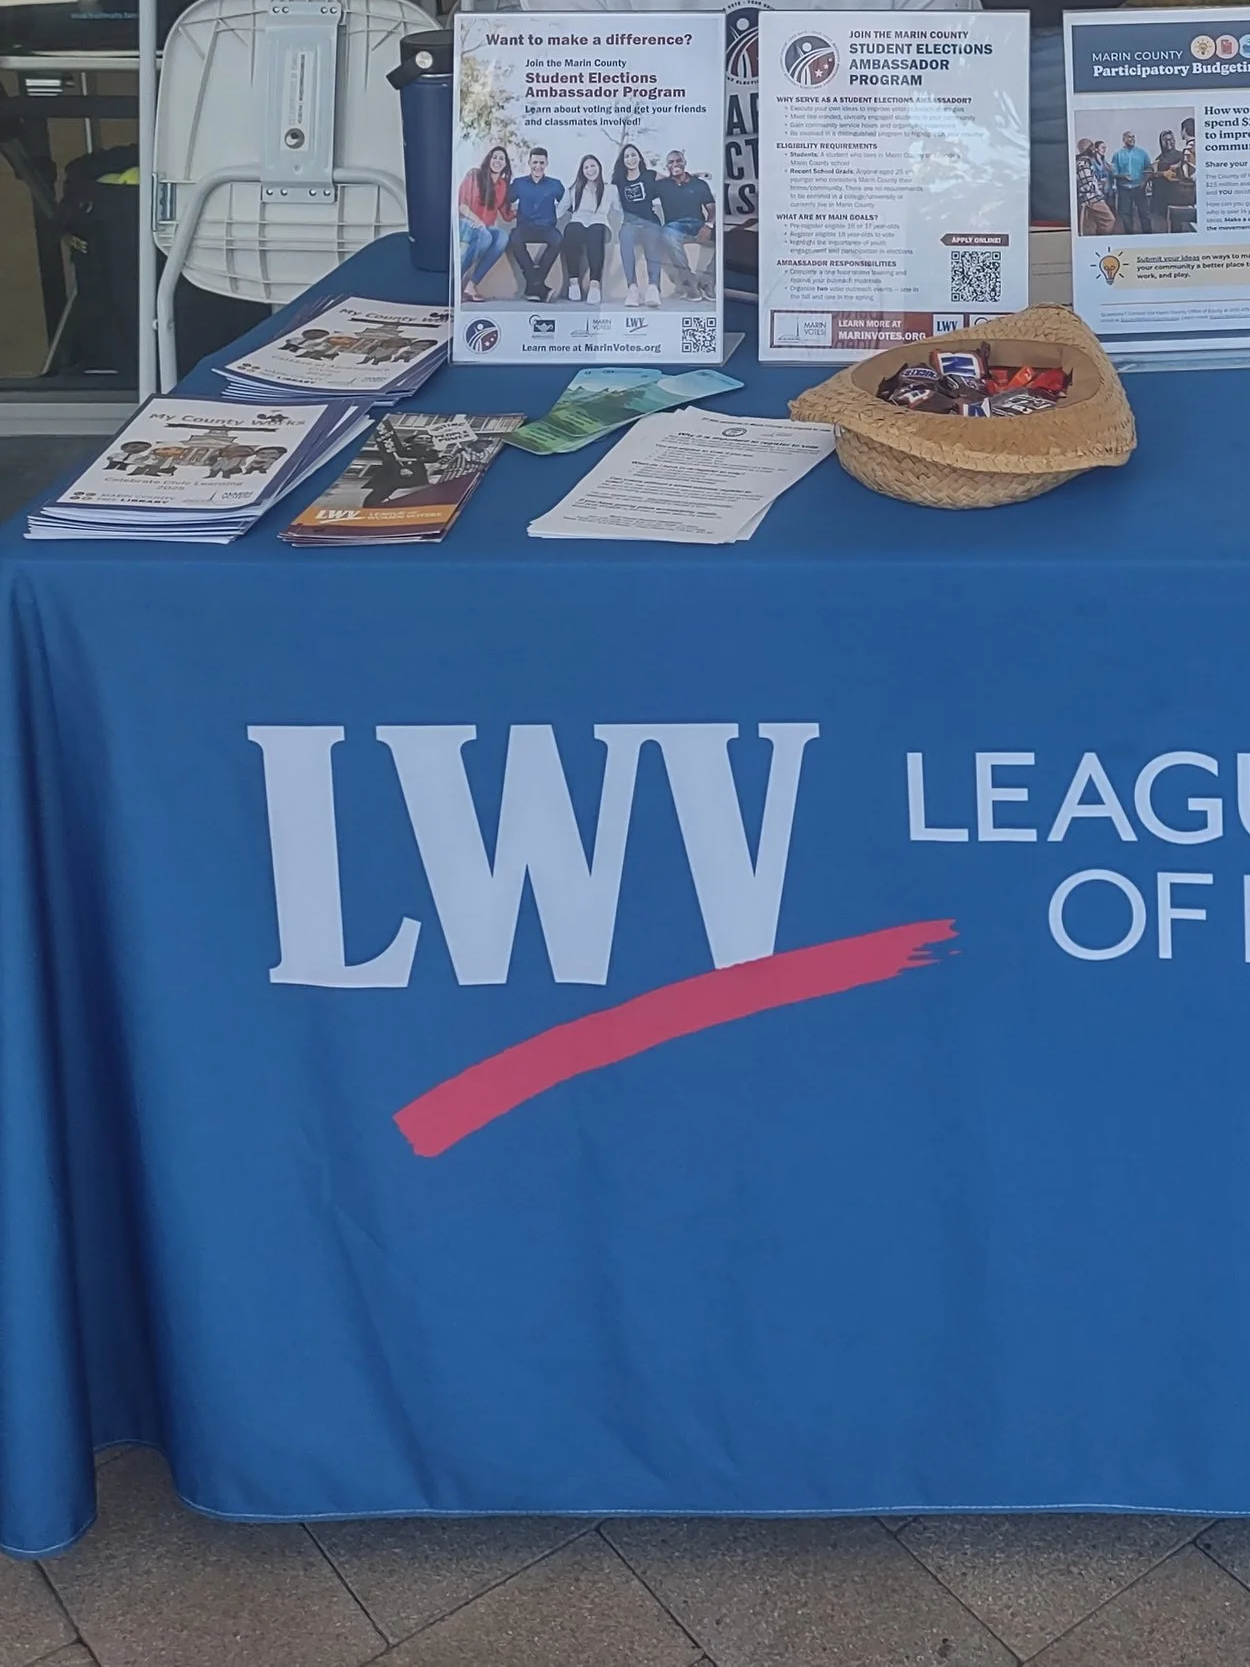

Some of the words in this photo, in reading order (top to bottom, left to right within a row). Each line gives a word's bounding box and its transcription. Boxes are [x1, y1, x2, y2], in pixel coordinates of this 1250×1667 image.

[485, 34, 524, 45] Want
[527, 34, 543, 45] to
[547, 34, 588, 45] make
[592, 36, 601, 45] a
[606, 33, 692, 45] difference?
[849, 30, 870, 38] JOIN
[873, 30, 891, 38] THE
[894, 31, 926, 39] MARIN
[929, 31, 968, 39] COUNTY
[849, 43, 912, 54] STUDENT
[916, 43, 992, 54] ELECTIONS
[1092, 52, 1130, 61] MARIN
[1134, 50, 1183, 60] COUNTY
[525, 59, 543, 67] Join
[546, 59, 561, 67] the
[564, 59, 591, 67] Marin
[594, 59, 626, 68] County
[849, 59, 949, 70] AMBASSADOR
[1093, 64, 1189, 77] Participatory
[525, 72, 583, 83] Student
[589, 72, 657, 83] Elections
[849, 74, 921, 85] PROGRAM
[525, 86, 618, 98] Ambassador
[623, 86, 685, 100] Program
[1204, 106, 1231, 115] How
[1204, 117, 1239, 129] spend
[626, 318, 645, 328] LWV
[838, 319, 864, 327] LEARN
[866, 320, 890, 329] MORE
[937, 321, 958, 332] LWV
[838, 331, 927, 342] MARINVOTES.ORG
[548, 345, 570, 354] more
[584, 343, 661, 354] MarinVotes.org
[314, 509, 361, 520] LWV
[247, 723, 819, 987] LWV
[1048, 869, 1214, 961] OF
